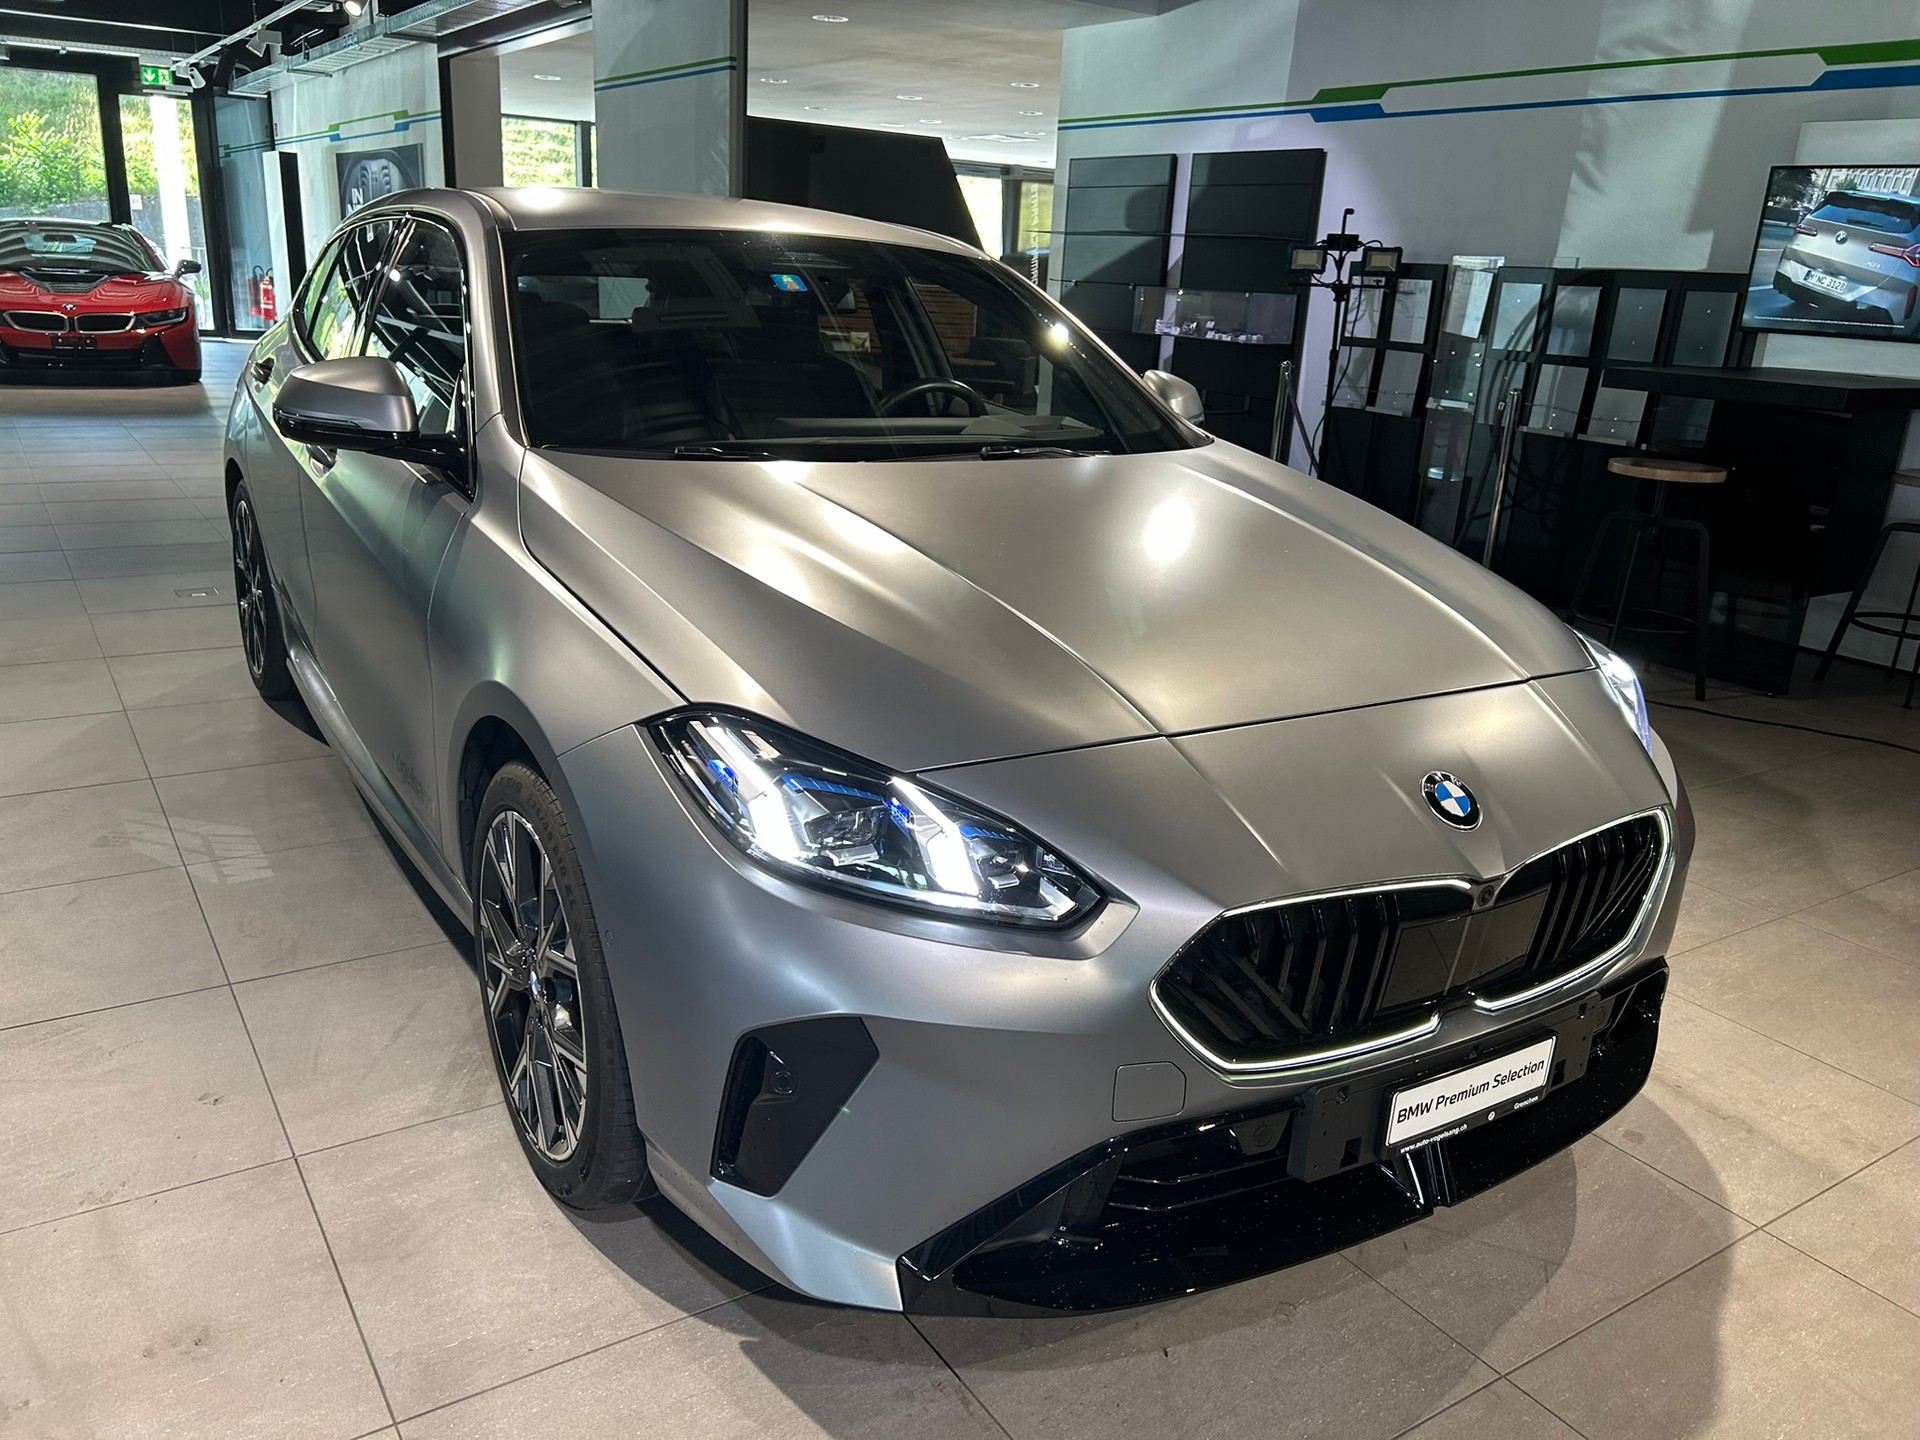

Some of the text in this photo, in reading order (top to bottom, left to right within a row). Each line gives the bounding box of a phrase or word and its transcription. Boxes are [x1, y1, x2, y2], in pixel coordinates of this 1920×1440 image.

[1397, 1060, 1544, 1124] BMW Premium Selection
[1400, 1124, 1468, 1154] www.auto-vogelsang.ch
